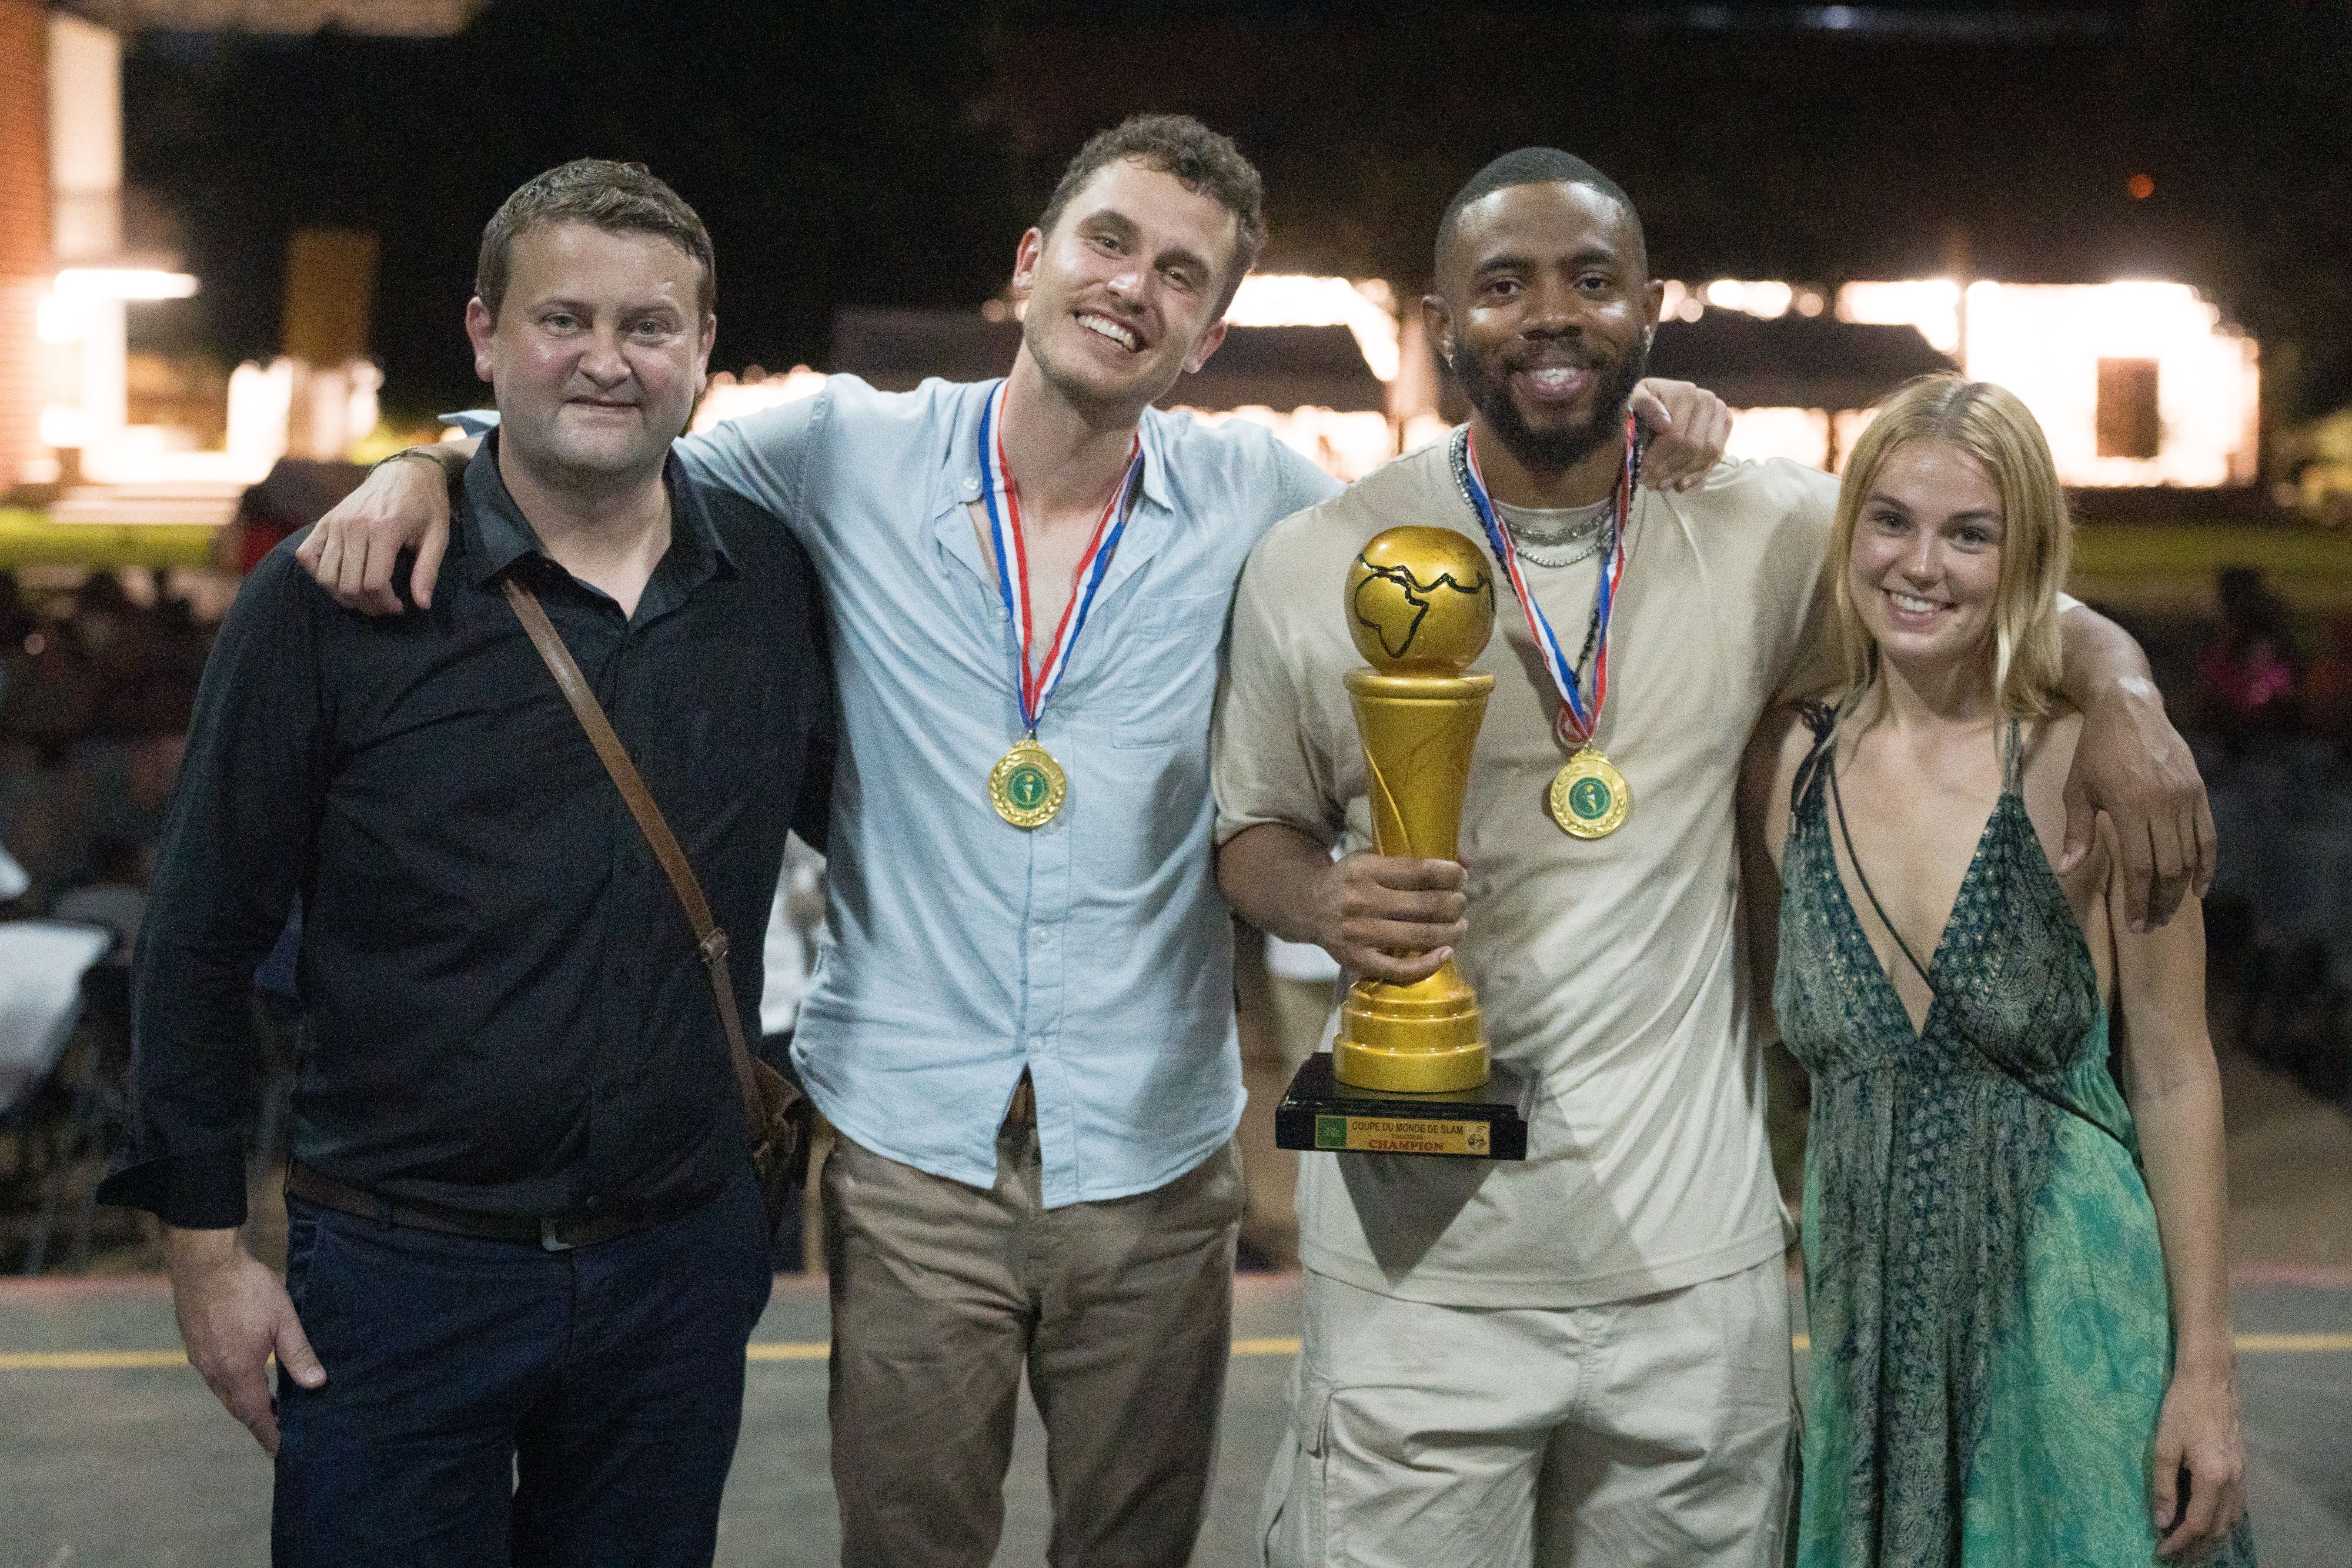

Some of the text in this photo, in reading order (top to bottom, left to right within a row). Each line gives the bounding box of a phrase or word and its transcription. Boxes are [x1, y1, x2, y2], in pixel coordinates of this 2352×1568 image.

[1352, 1121, 1463, 1135] COUPE DU MONDE DE SLAM
[1368, 1139, 1444, 1151] CHAMPION
